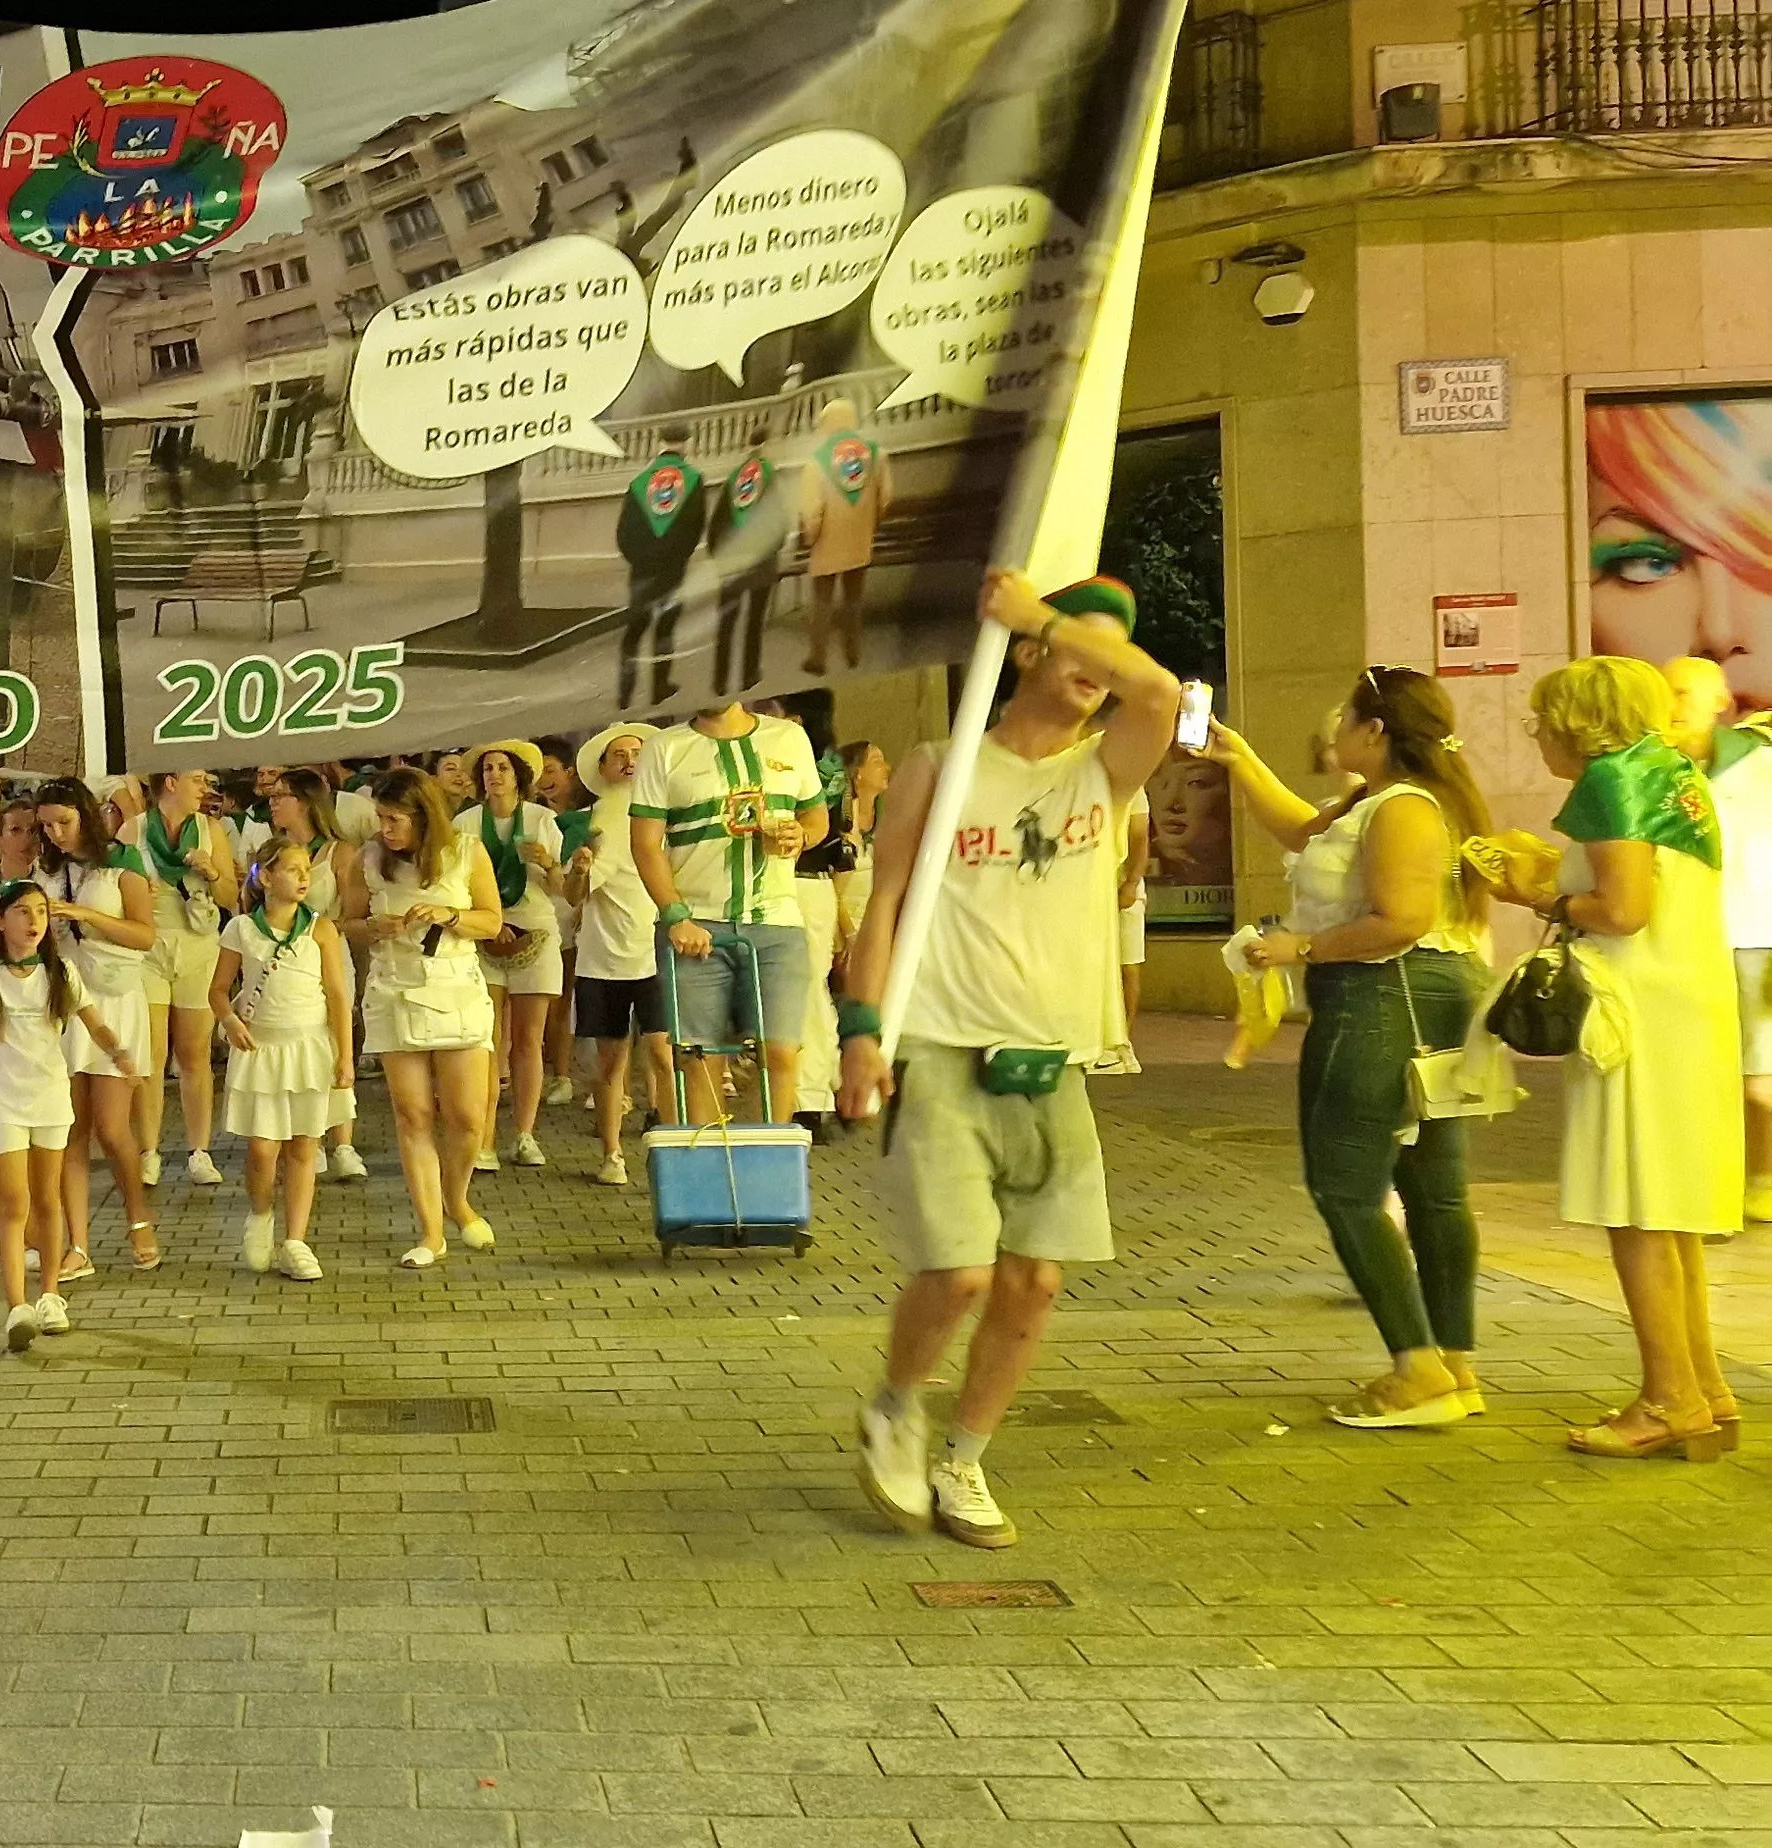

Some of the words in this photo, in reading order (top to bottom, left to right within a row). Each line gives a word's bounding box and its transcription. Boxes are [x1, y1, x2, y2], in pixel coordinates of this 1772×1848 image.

[104, 178, 161, 202] LA
[713, 187, 792, 219] Menos
[799, 175, 879, 205] dinero
[964, 198, 1028, 237] Ojalá
[20, 218, 230, 266] PARRILLA
[674, 240, 729, 274] para
[736, 231, 757, 257] la
[909, 258, 949, 285] las
[956, 236, 1075, 280] siguientes
[393, 291, 477, 322] Estás
[486, 282, 568, 312] obras
[577, 273, 629, 300] van
[664, 278, 715, 309] más
[723, 274, 782, 307] para
[789, 263, 812, 291] el
[885, 301, 969, 330] obras,
[975, 289, 1024, 316] sean
[1028, 280, 1066, 301] las
[385, 336, 448, 368] más
[455, 324, 569, 363] rápidas
[578, 318, 629, 351] que
[939, 340, 961, 364] la
[965, 331, 1022, 365] plaza
[1028, 321, 1056, 346] de
[448, 377, 490, 405] las
[500, 372, 533, 399] de
[544, 368, 568, 395] la
[1438, 385, 1500, 403] PADRE
[1444, 370, 1492, 385] CALLE
[424, 410, 572, 452] Romareda
[1415, 403, 1496, 422] HUESCA
[153, 641, 406, 745] 2025
